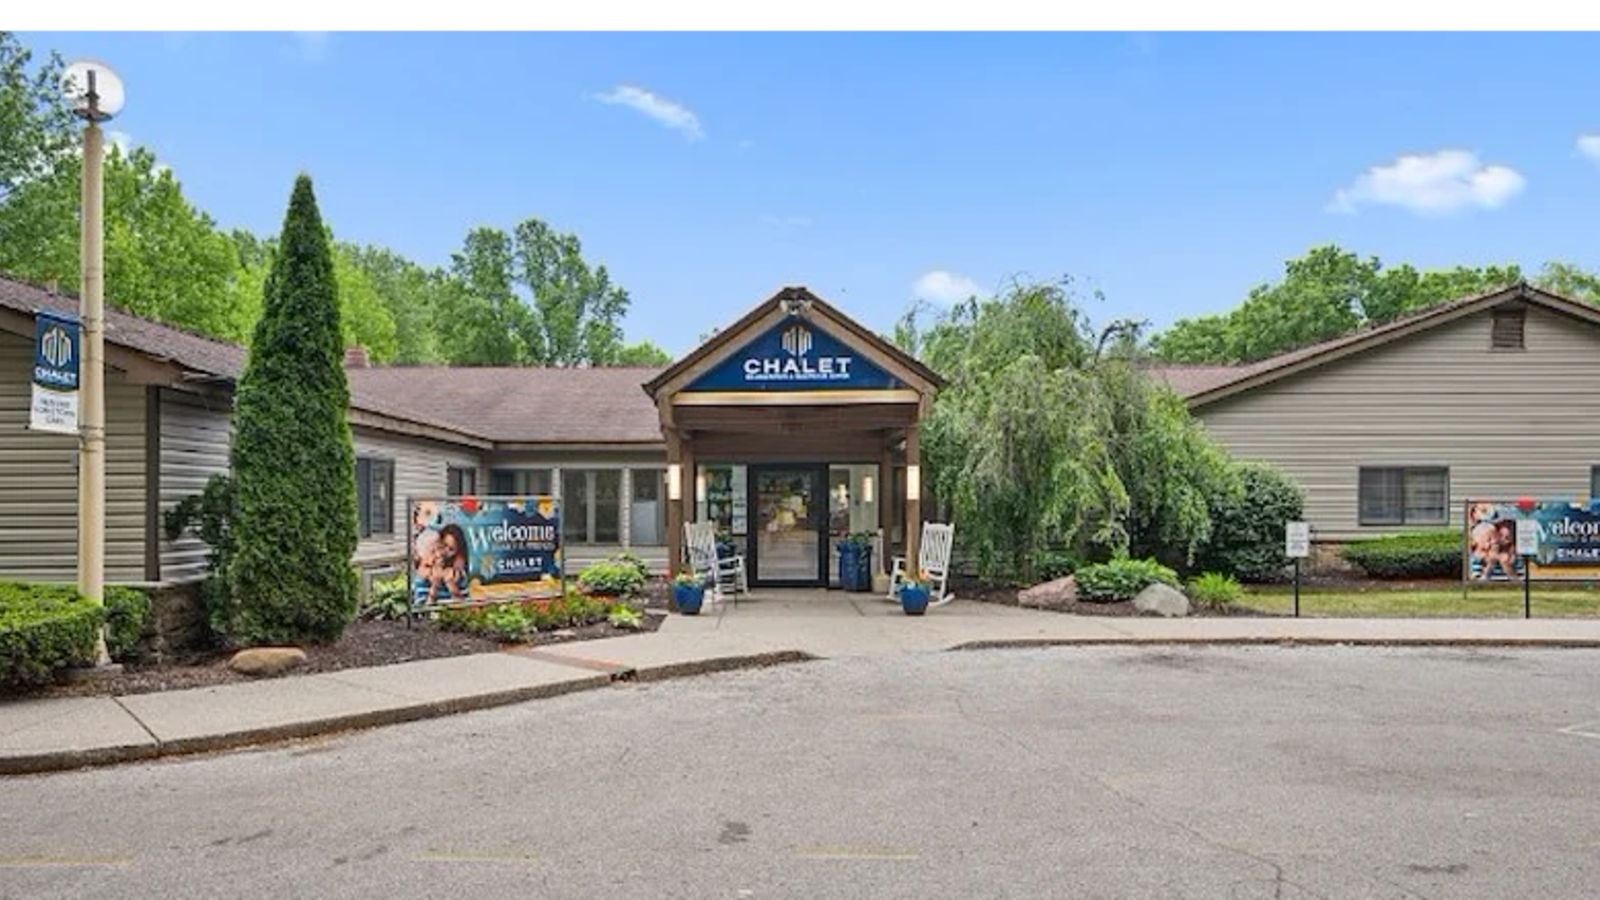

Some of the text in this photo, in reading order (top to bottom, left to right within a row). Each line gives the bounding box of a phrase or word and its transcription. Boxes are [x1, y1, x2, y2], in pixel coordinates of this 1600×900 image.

[35, 366, 77, 380] CHALET
[743, 357, 852, 374] CHALET
[468, 519, 555, 550] Welcome
[497, 557, 543, 569] CHALET
